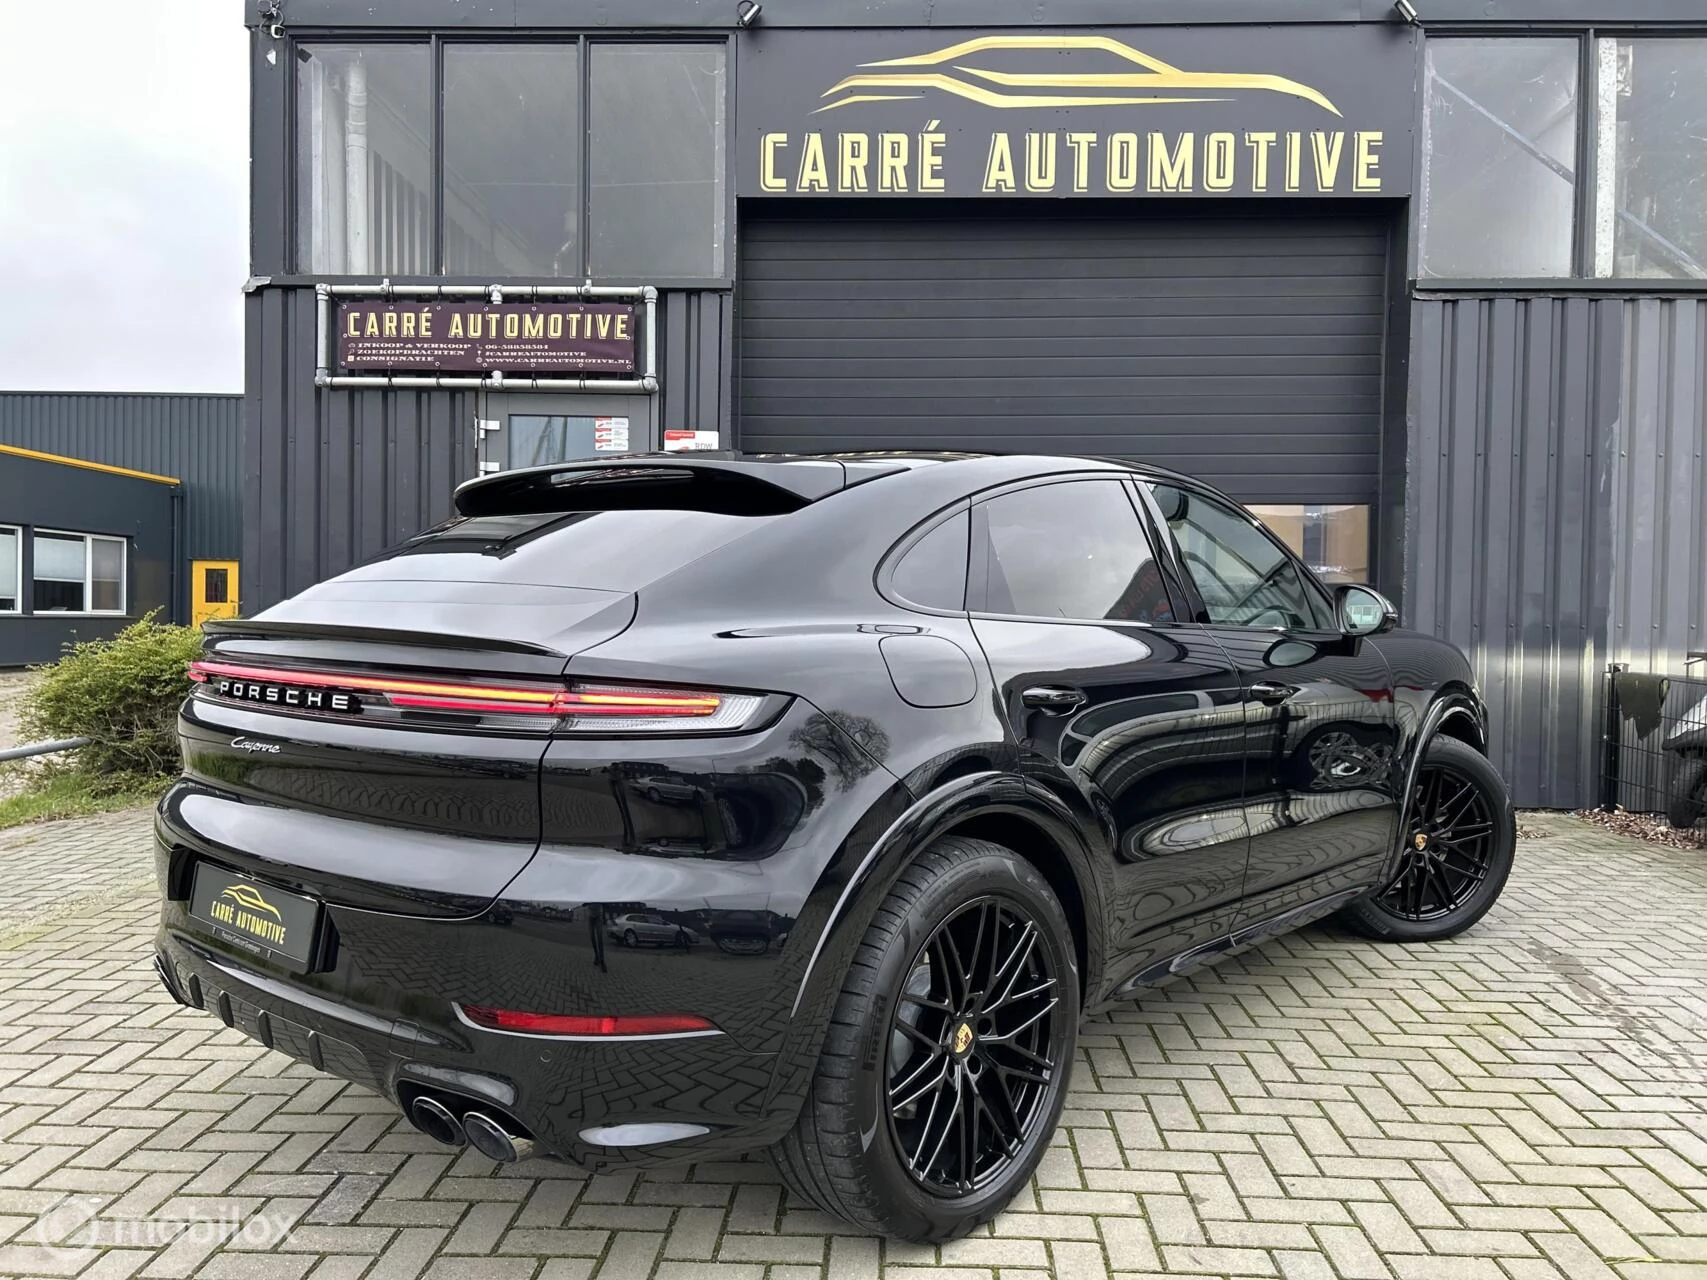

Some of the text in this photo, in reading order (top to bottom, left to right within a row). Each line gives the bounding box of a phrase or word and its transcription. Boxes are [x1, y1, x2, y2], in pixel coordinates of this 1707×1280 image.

[760, 119, 1384, 192] CARRÉ AUTOMOTIVE
[347, 307, 629, 339] CARRÉ AUTOMOTIVE
[219, 681, 350, 710] PORSCHE
[230, 736, 281, 754] Cayenne
[210, 900, 235, 924] CARRÉ
[235, 909, 287, 945] AUTOMOTIVE
